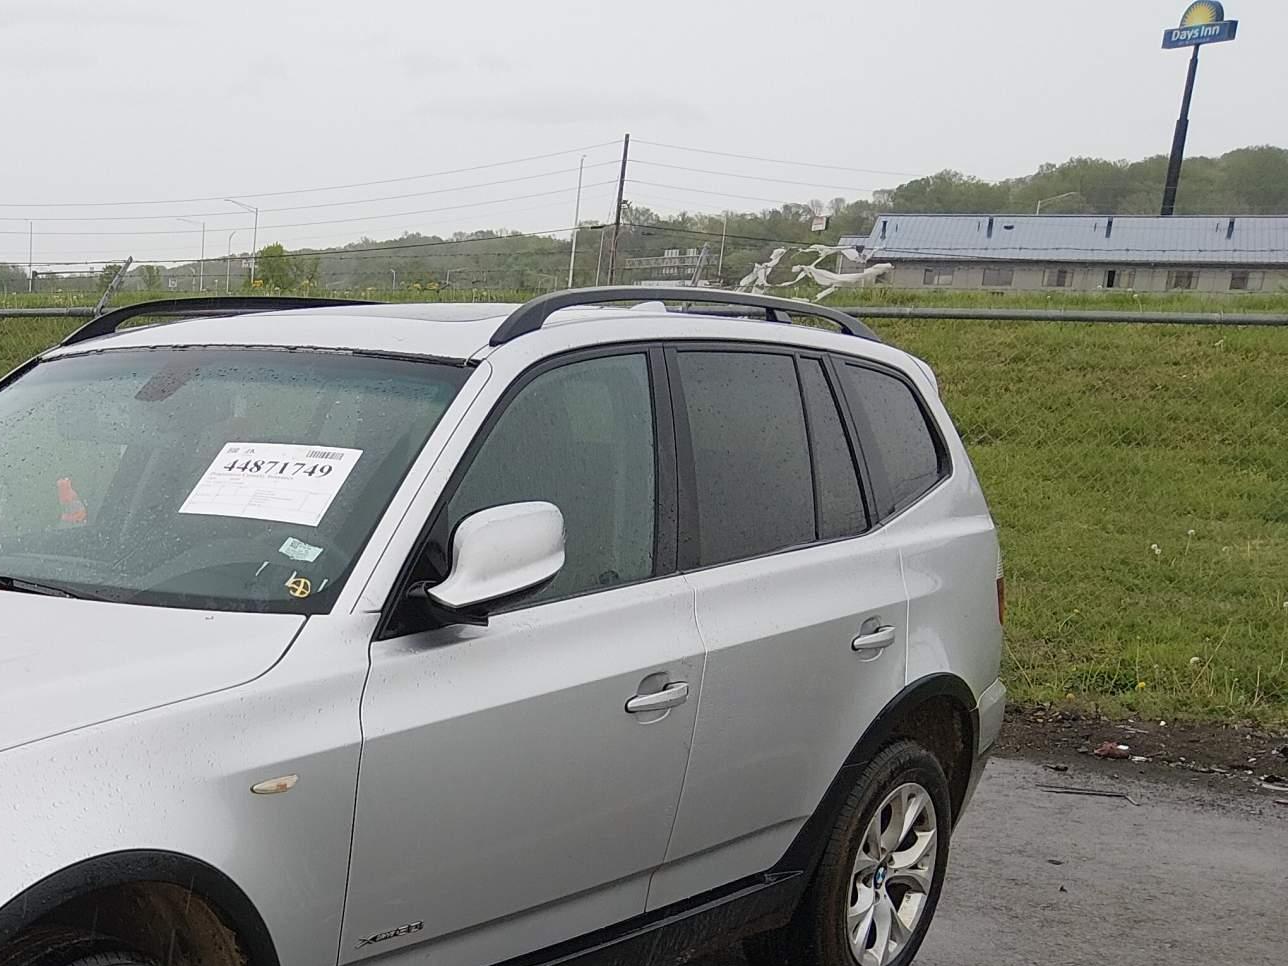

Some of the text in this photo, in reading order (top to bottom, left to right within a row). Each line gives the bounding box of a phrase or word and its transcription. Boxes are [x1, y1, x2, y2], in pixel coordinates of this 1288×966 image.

[1171, 25, 1220, 41] Days Inn
[223, 458, 333, 478] 44871749
